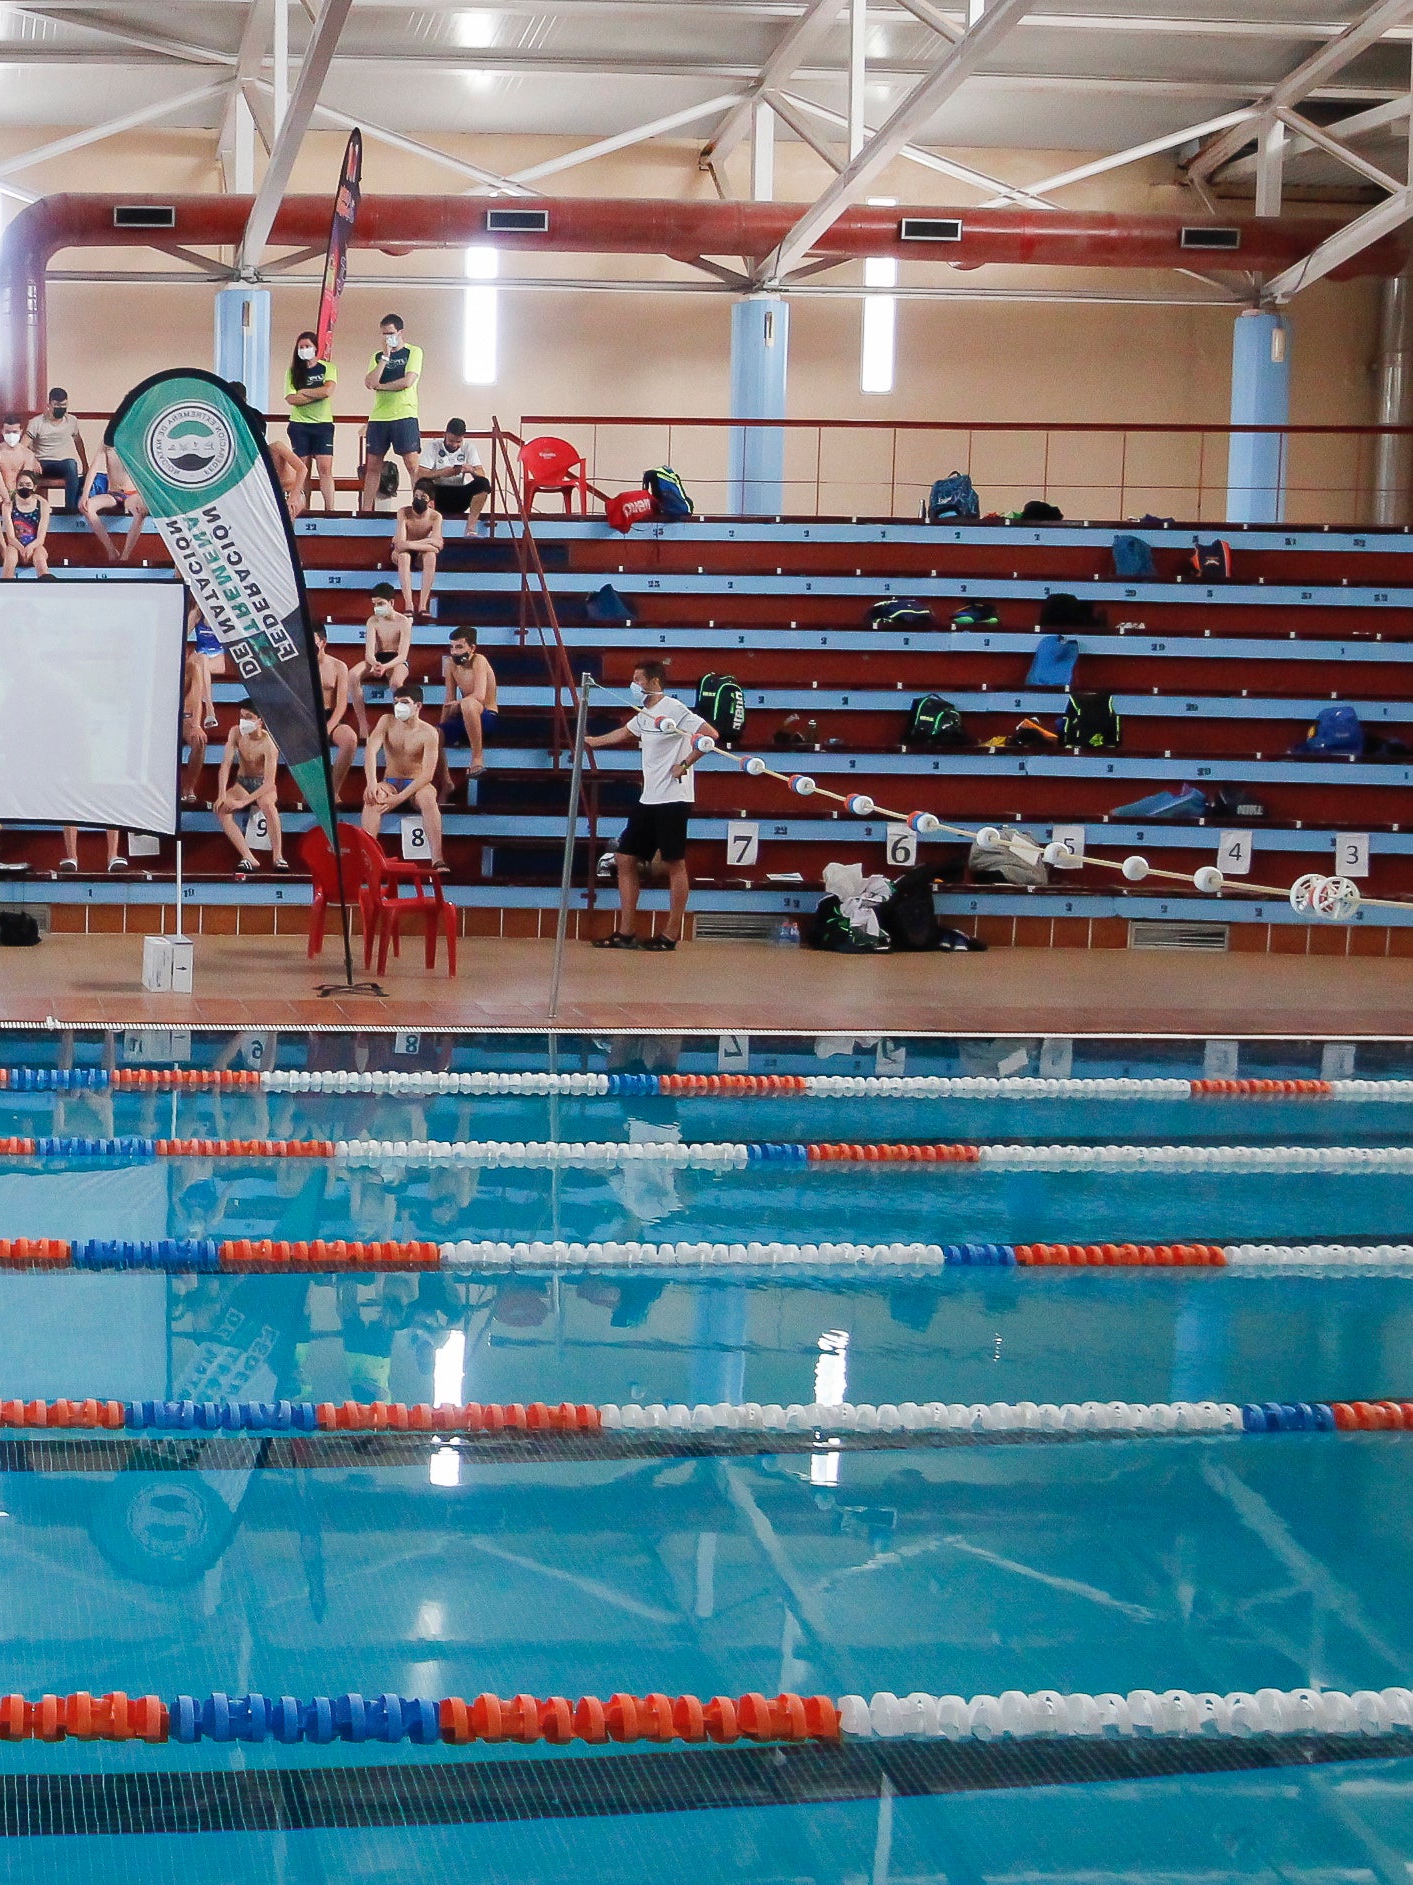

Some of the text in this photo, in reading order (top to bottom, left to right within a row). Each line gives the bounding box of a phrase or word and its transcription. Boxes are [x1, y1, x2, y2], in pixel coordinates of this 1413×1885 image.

[257, 818, 267, 838] 9
[412, 828, 424, 847] 8
[732, 835, 753, 862] 7
[890, 834, 912, 863] 6
[1063, 837, 1076, 855] 5
[1228, 842, 1243, 862] 4
[1346, 845, 1358, 864] 3
